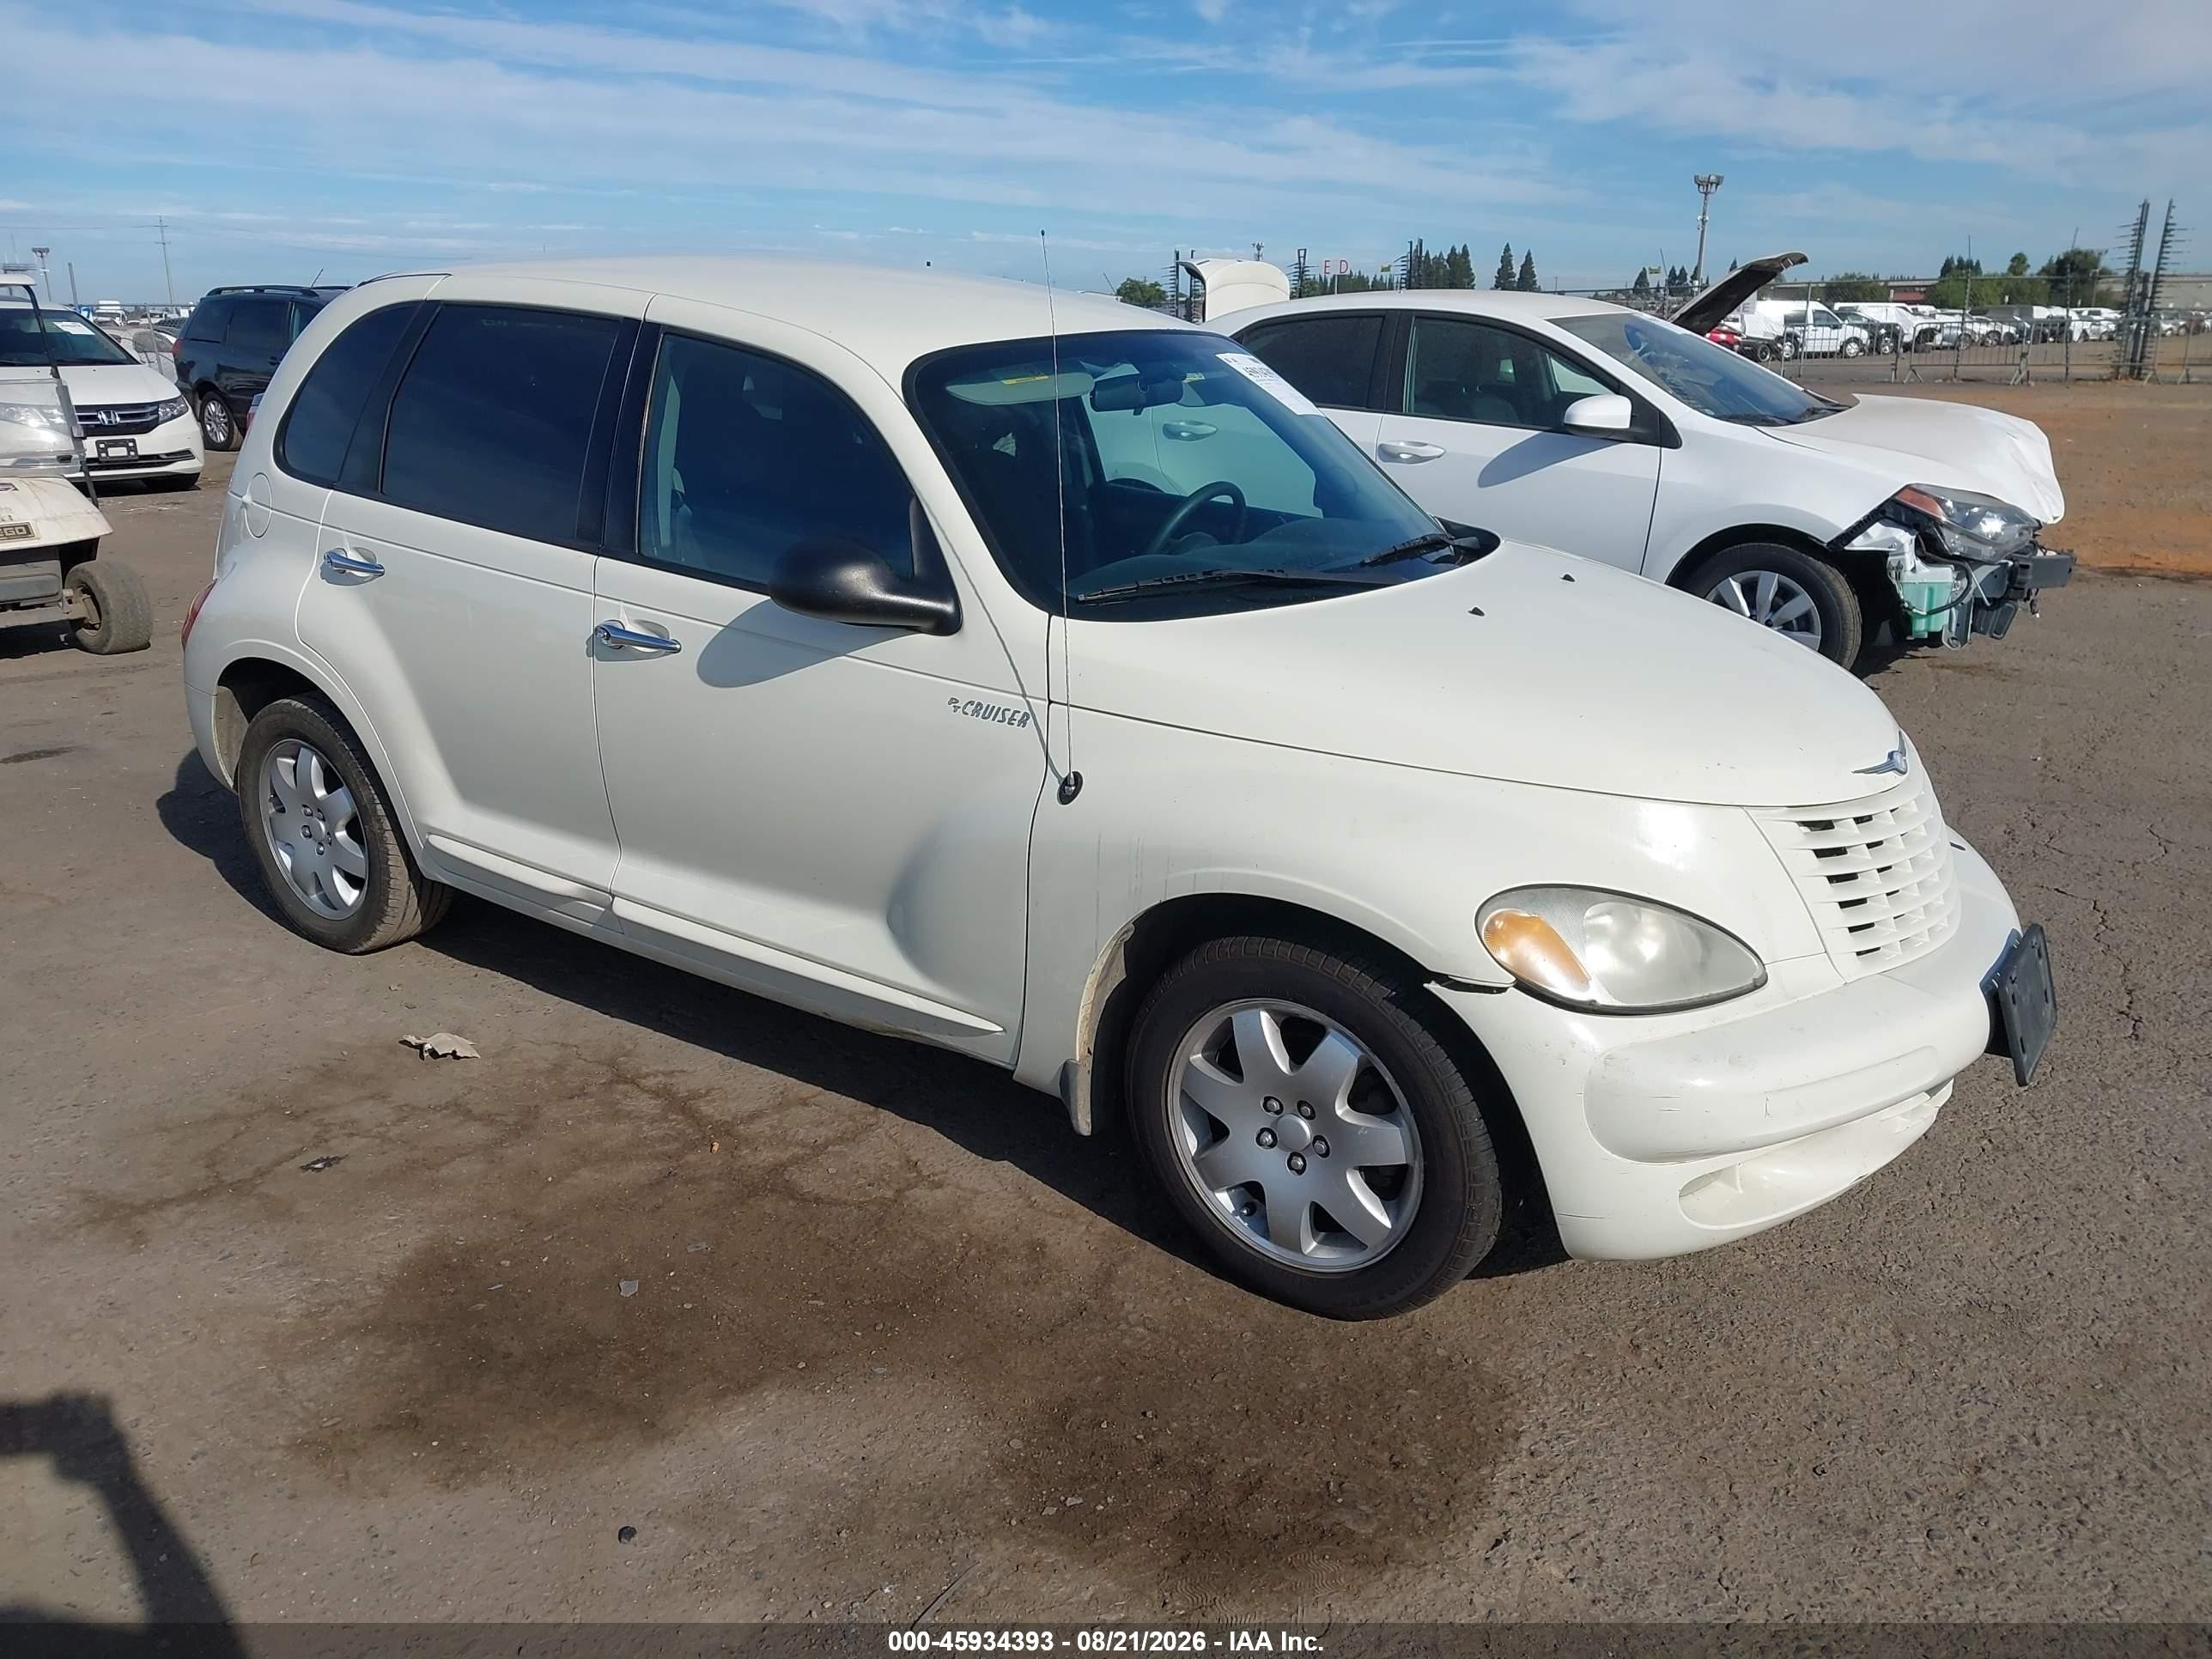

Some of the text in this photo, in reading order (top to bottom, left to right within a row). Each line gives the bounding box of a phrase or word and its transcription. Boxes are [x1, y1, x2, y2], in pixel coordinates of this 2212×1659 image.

[1324, 259, 1349, 275] E D
[947, 696, 1030, 728] PT CRUISER
